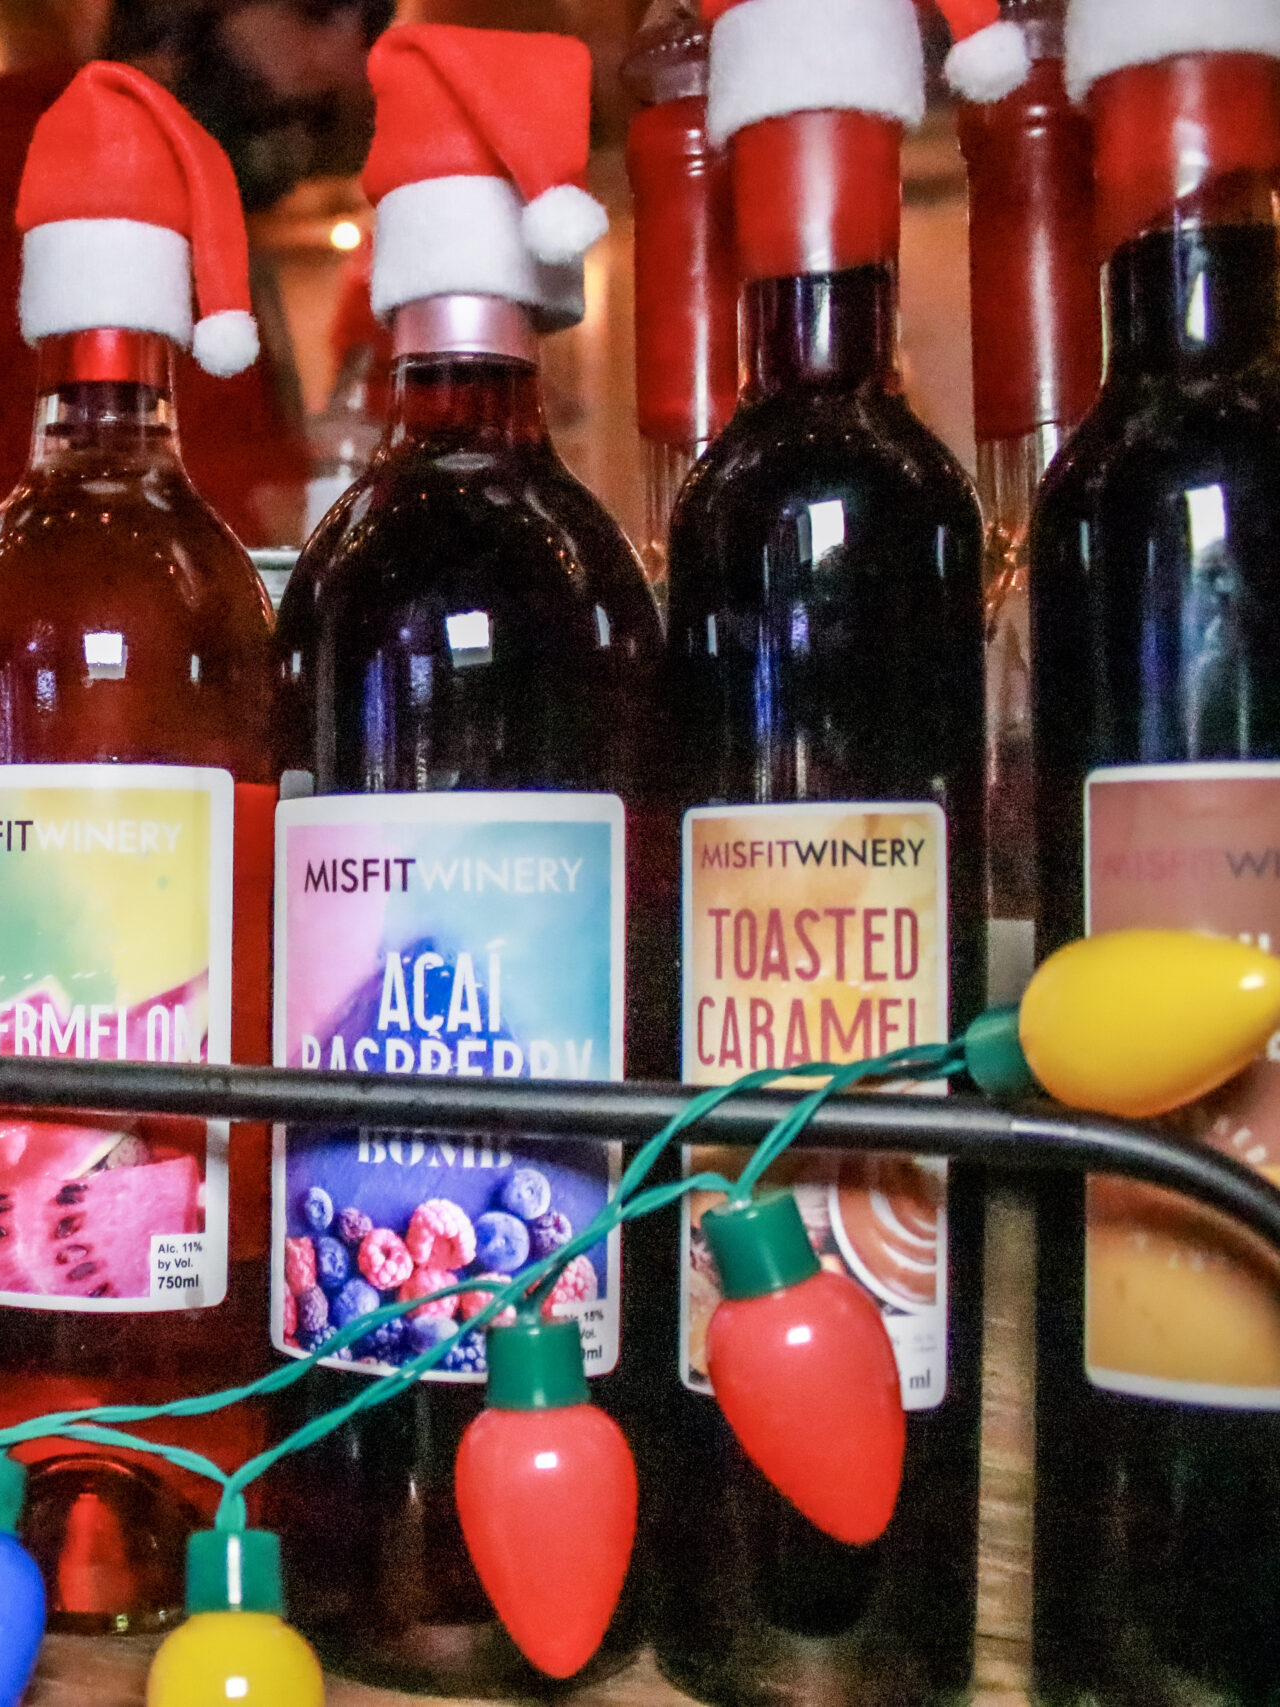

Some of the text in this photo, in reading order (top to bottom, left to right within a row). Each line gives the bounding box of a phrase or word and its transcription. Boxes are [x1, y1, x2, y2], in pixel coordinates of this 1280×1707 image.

[708, 908, 919, 981] TOASTED
[158, 1242, 202, 1254] Alc. 11%
[158, 1258, 193, 1271] by Vol.
[158, 1274, 199, 1289] 750ml
